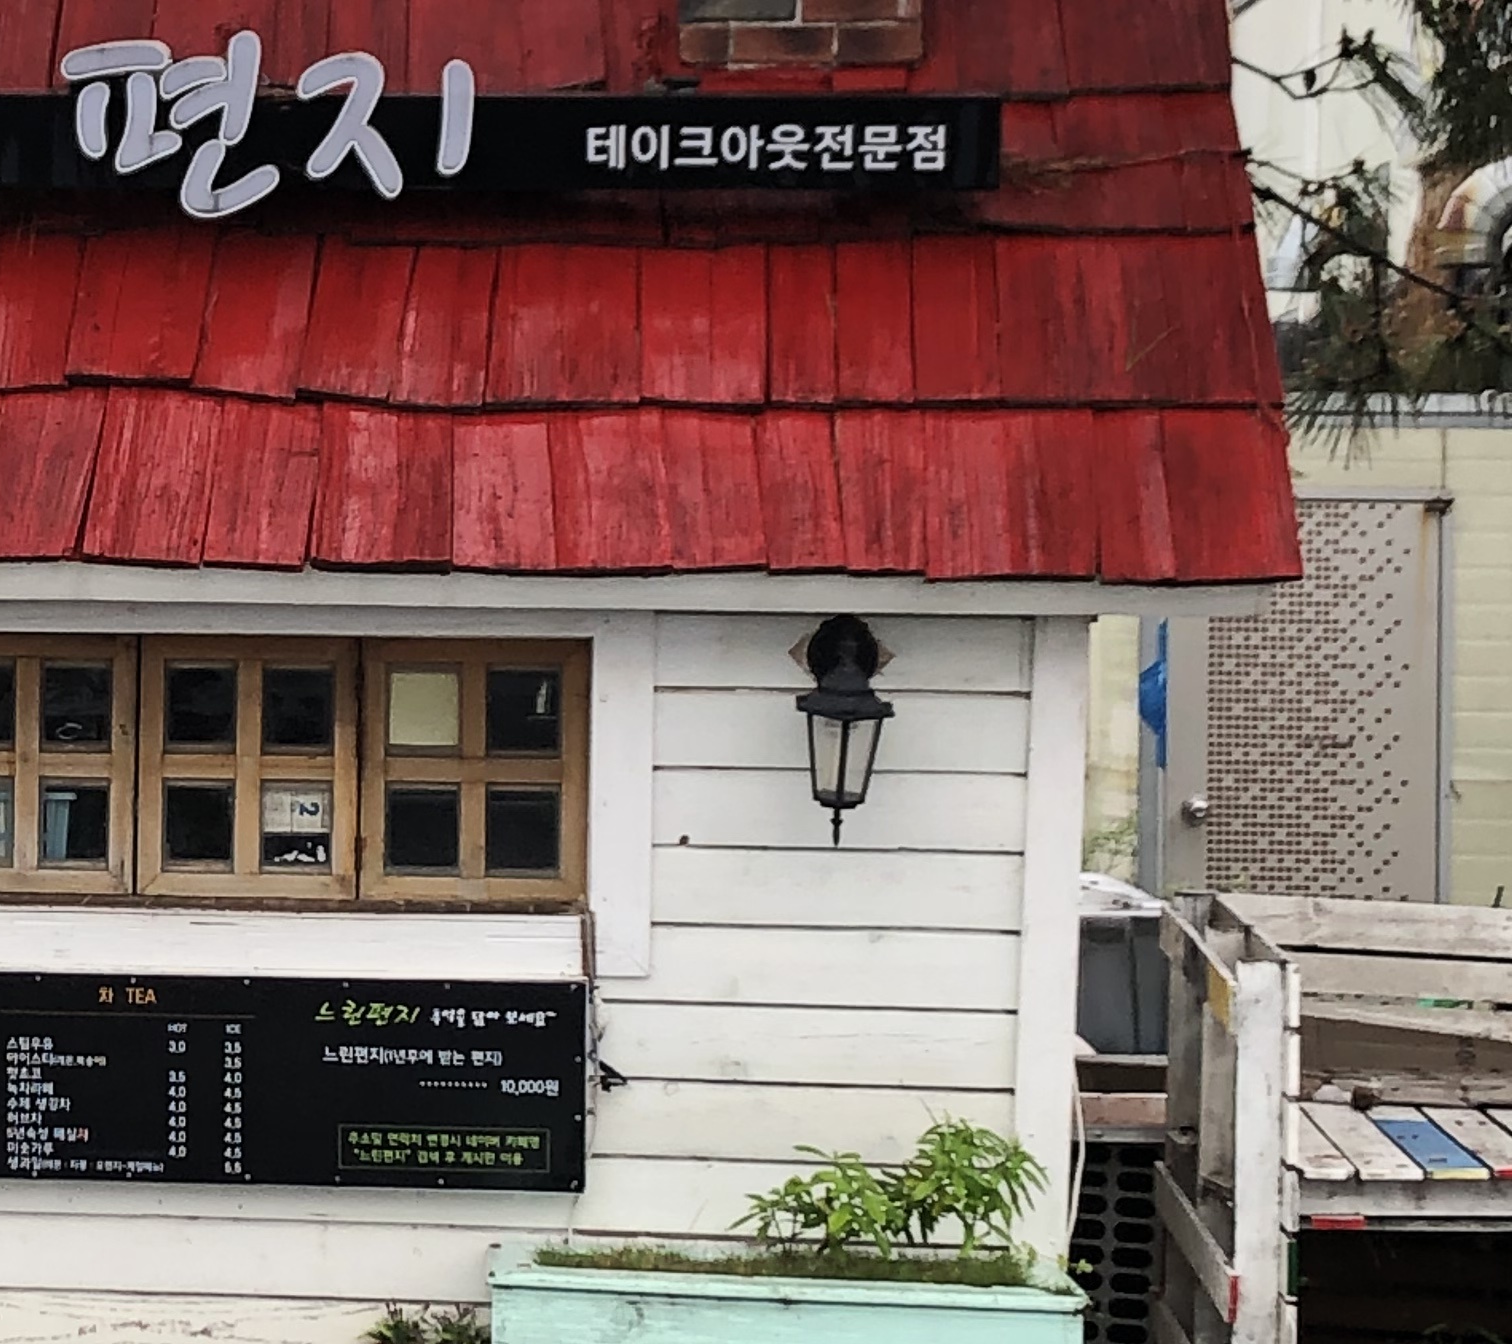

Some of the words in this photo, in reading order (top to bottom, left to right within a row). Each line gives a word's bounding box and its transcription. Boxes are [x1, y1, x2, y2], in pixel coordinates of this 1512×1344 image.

[60, 29, 476, 218] 편지
[585, 123, 948, 172] 테이크아웃전문점
[98, 986, 114, 1004] 차
[125, 987, 157, 1004] TEA
[315, 999, 420, 1026] 느린편지
[501, 1079, 559, 1097] 10,000원
